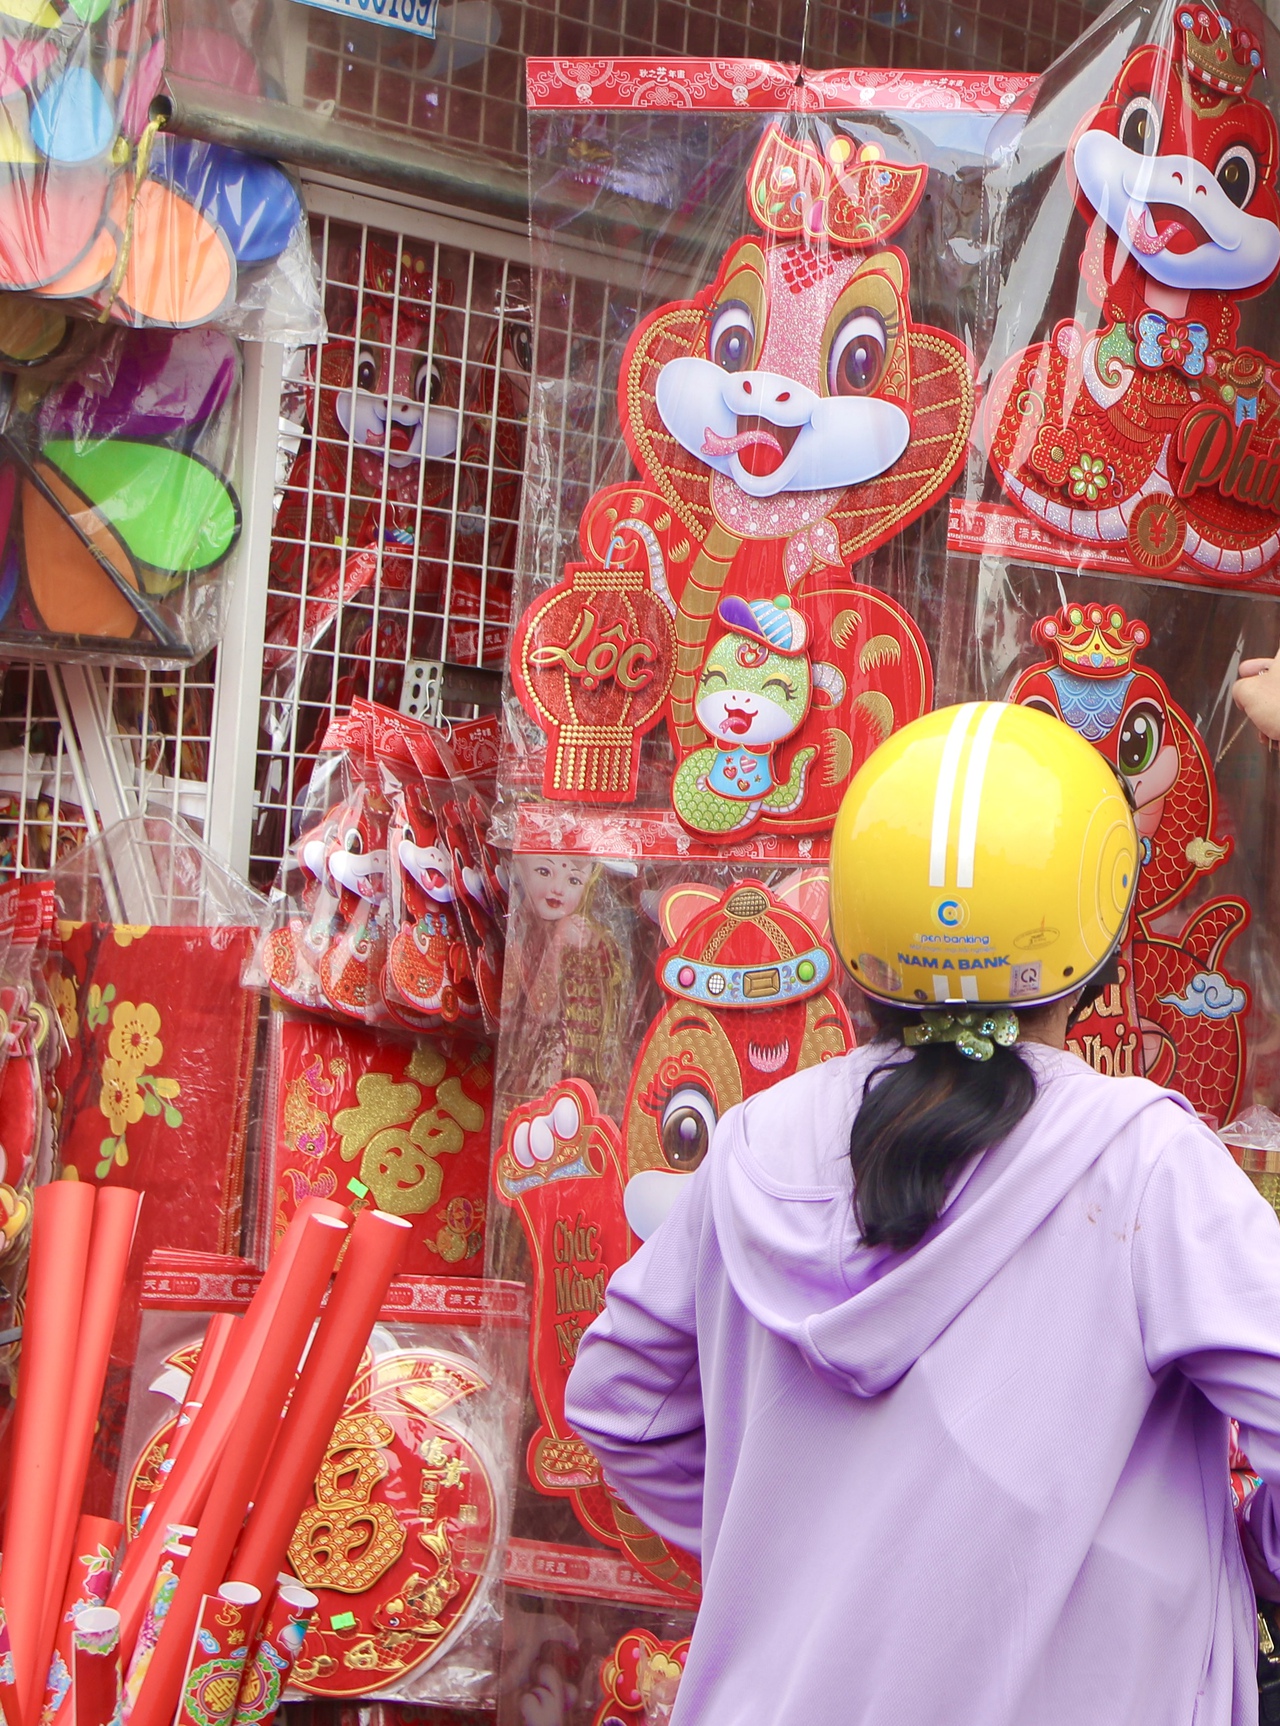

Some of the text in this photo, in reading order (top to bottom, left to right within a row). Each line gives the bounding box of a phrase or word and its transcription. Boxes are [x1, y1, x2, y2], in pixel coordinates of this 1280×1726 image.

[529, 608, 652, 688] Lộc
[943, 934, 990, 945] banking
[897, 952, 1011, 970] NAM A BANK
[553, 1213, 598, 1265] Chúc
